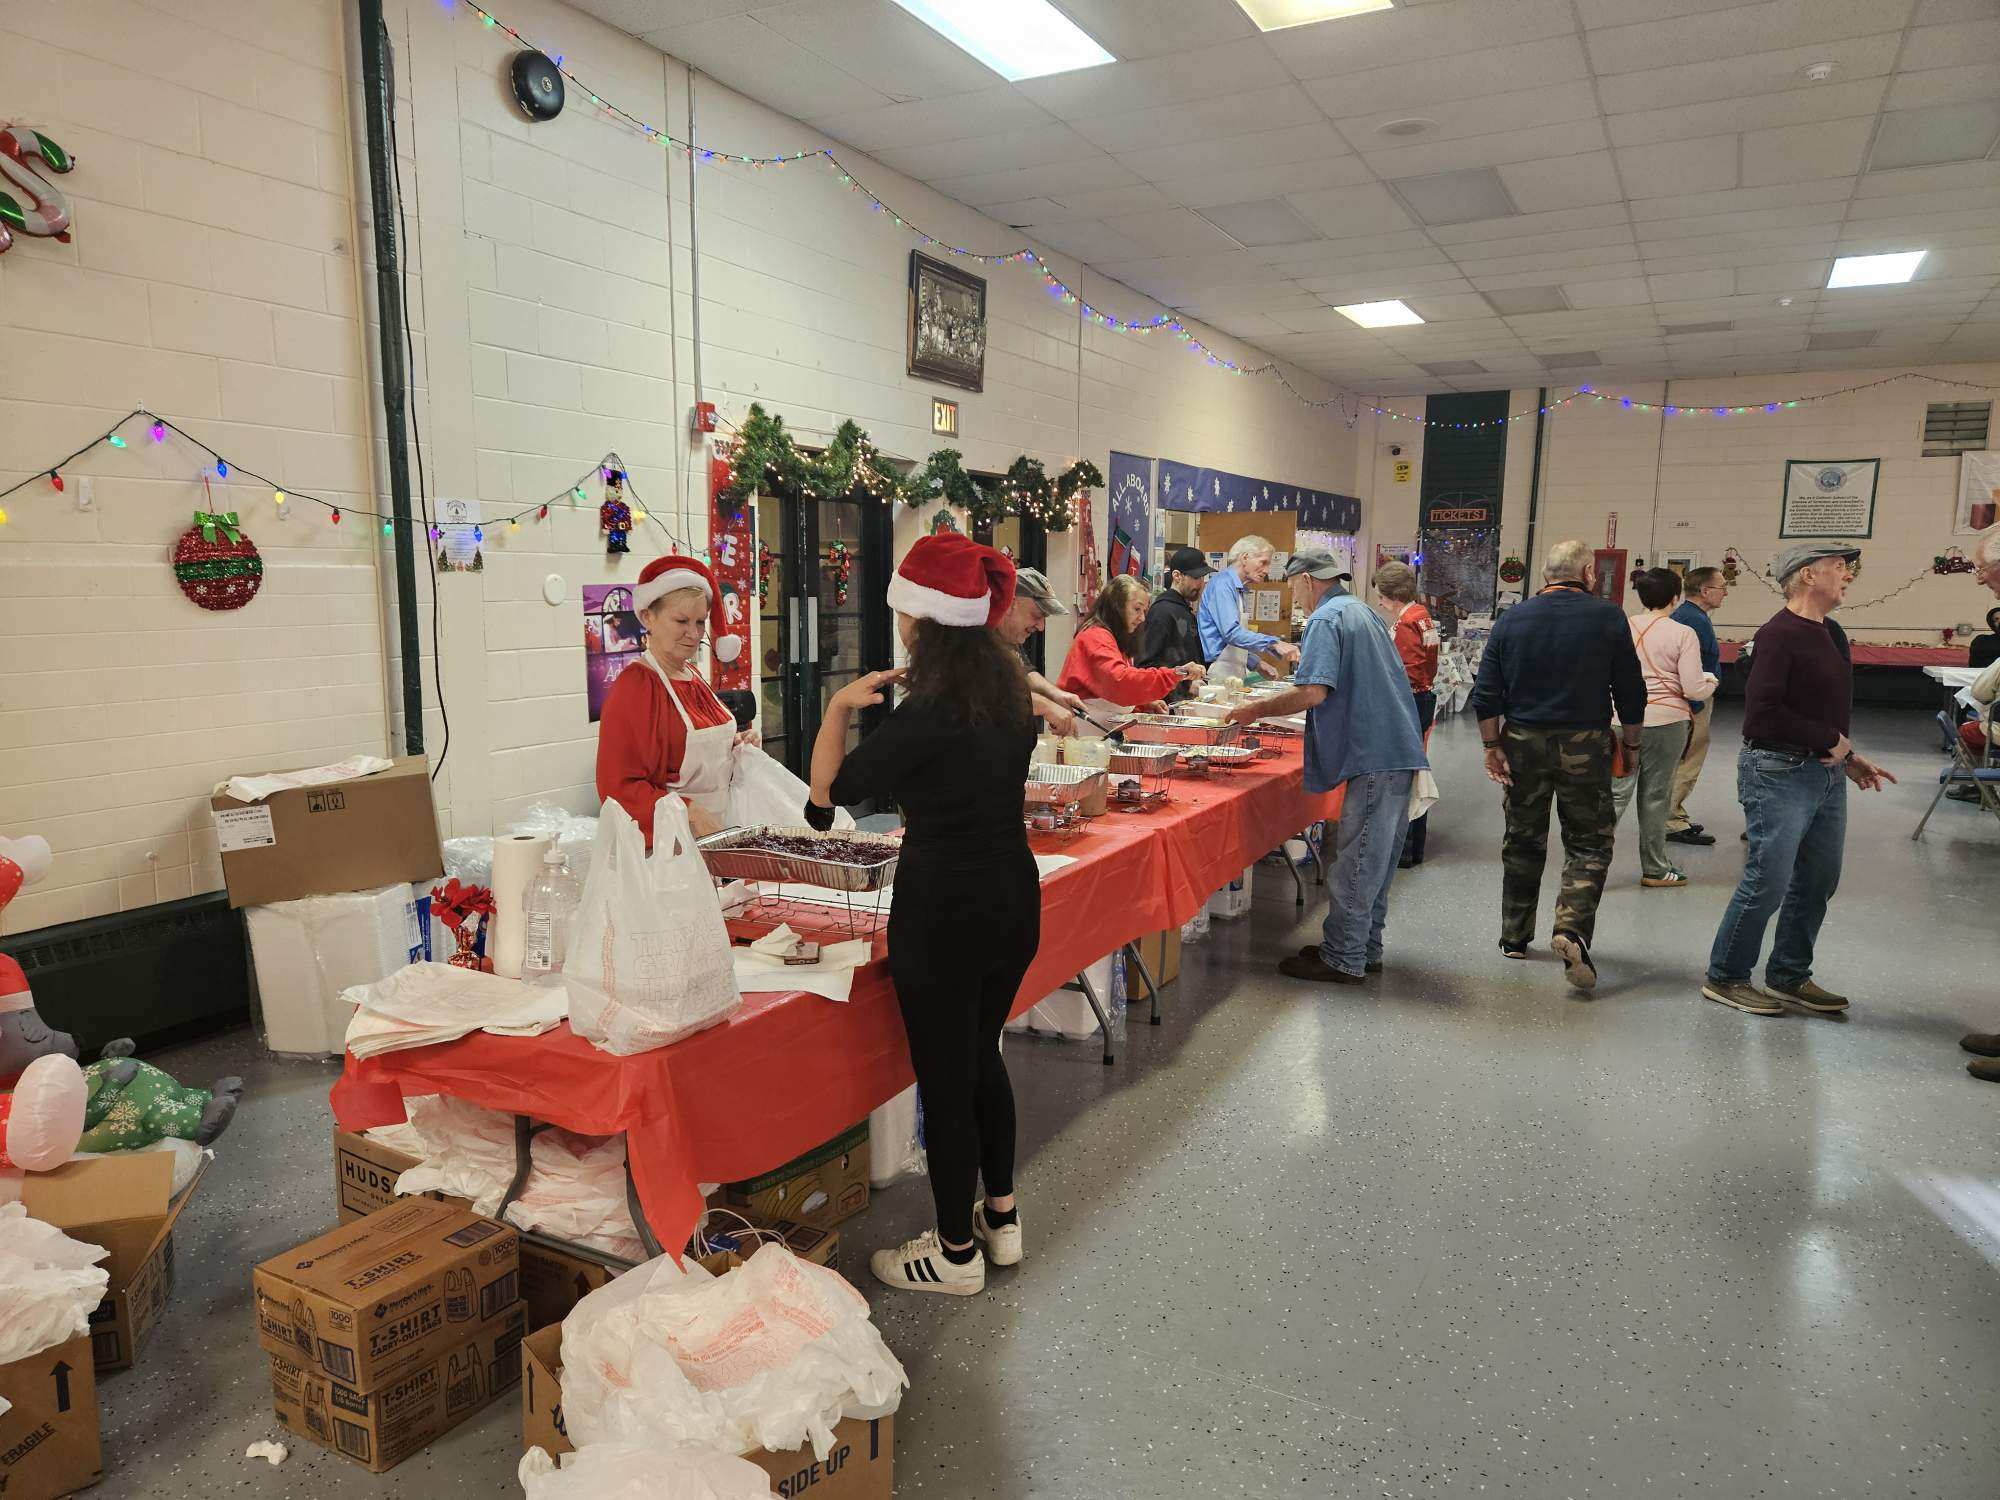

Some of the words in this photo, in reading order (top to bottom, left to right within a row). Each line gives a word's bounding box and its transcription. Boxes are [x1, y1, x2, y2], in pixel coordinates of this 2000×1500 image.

[934, 402, 956, 432] EXIT
[1112, 482, 1126, 513] ALL
[1126, 473, 1149, 517] ABOARD
[1432, 511, 1481, 521] TICKETS
[345, 1159, 399, 1194] HUDS
[494, 1239, 515, 1255] 1000
[344, 1251, 417, 1287] T-SHIRT
[260, 1312, 292, 1341] T-SHIRT
[331, 1310, 351, 1324] 1000
[369, 1303, 441, 1348] T-SHIRT
[370, 1329, 419, 1357] CARRY-OUT
[421, 1316, 442, 1333] BAGS
[273, 1355, 302, 1380] T-SHIRT
[382, 1367, 436, 1407] T-SHIRT
[1, 1421, 55, 1465] FRAGILE
[778, 1461, 820, 1499] SIDE
[826, 1444, 851, 1476] UP
